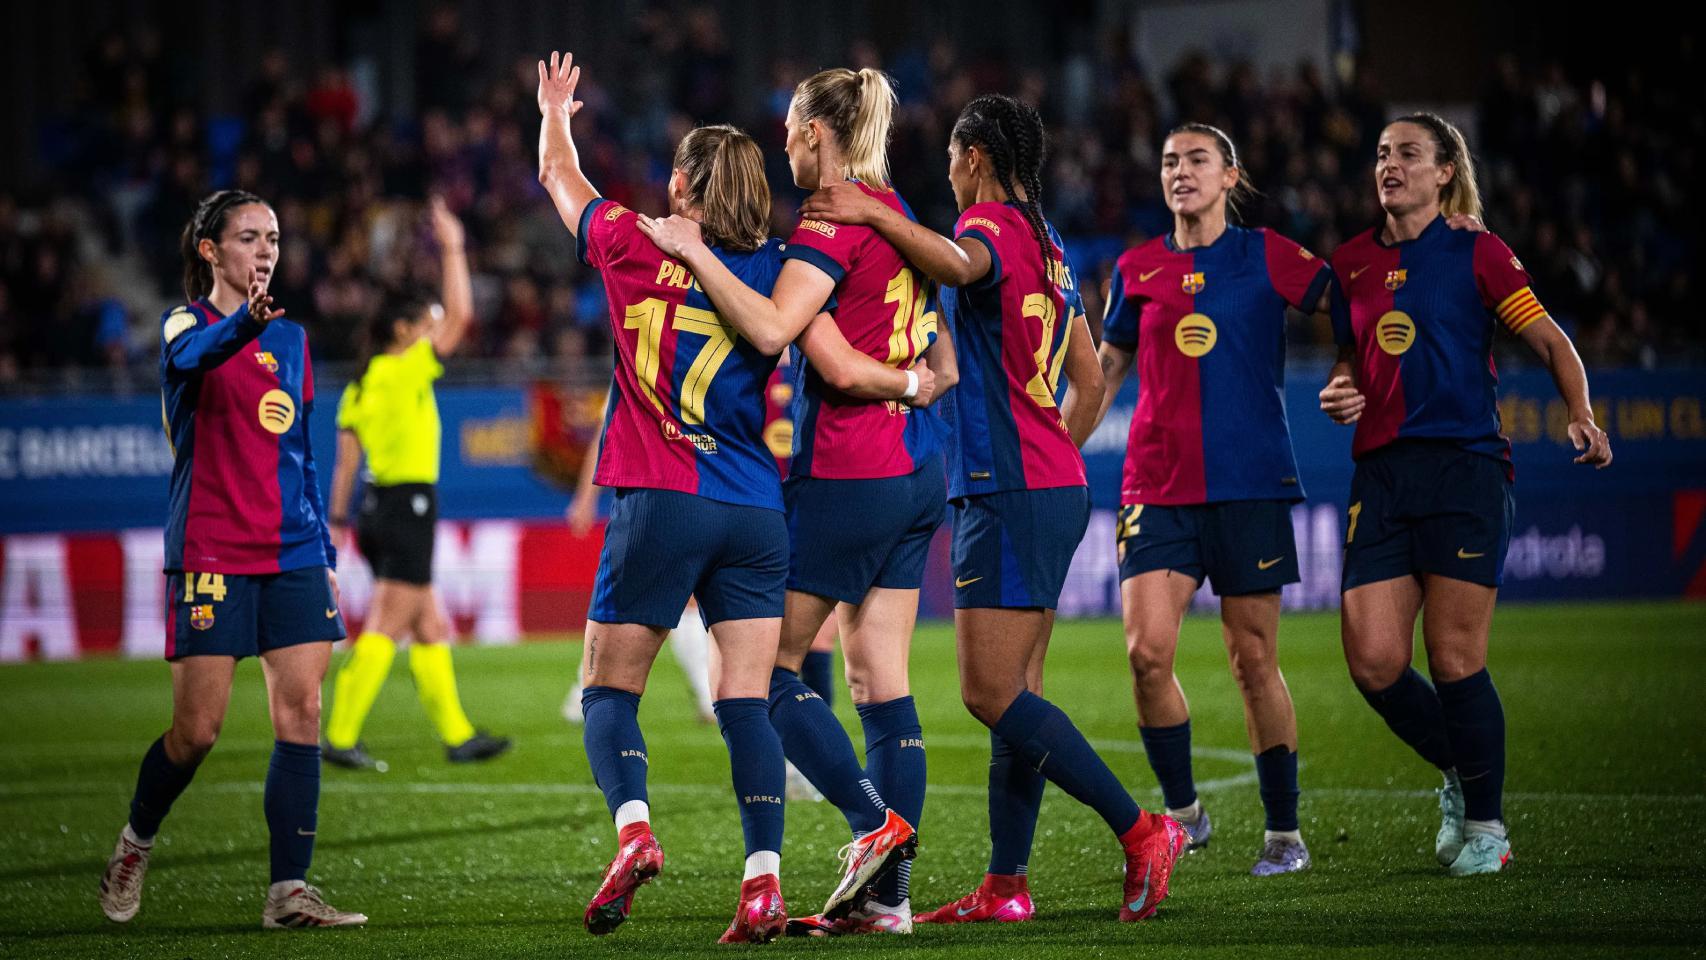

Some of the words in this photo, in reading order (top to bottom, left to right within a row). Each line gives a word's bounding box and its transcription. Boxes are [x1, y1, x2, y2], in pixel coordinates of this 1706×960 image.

[800, 219, 836, 237] BIMBO
[964, 218, 1000, 235] BIMBO
[884, 267, 938, 370] 16
[623, 297, 738, 425] 17
[184, 571, 228, 602] 14
